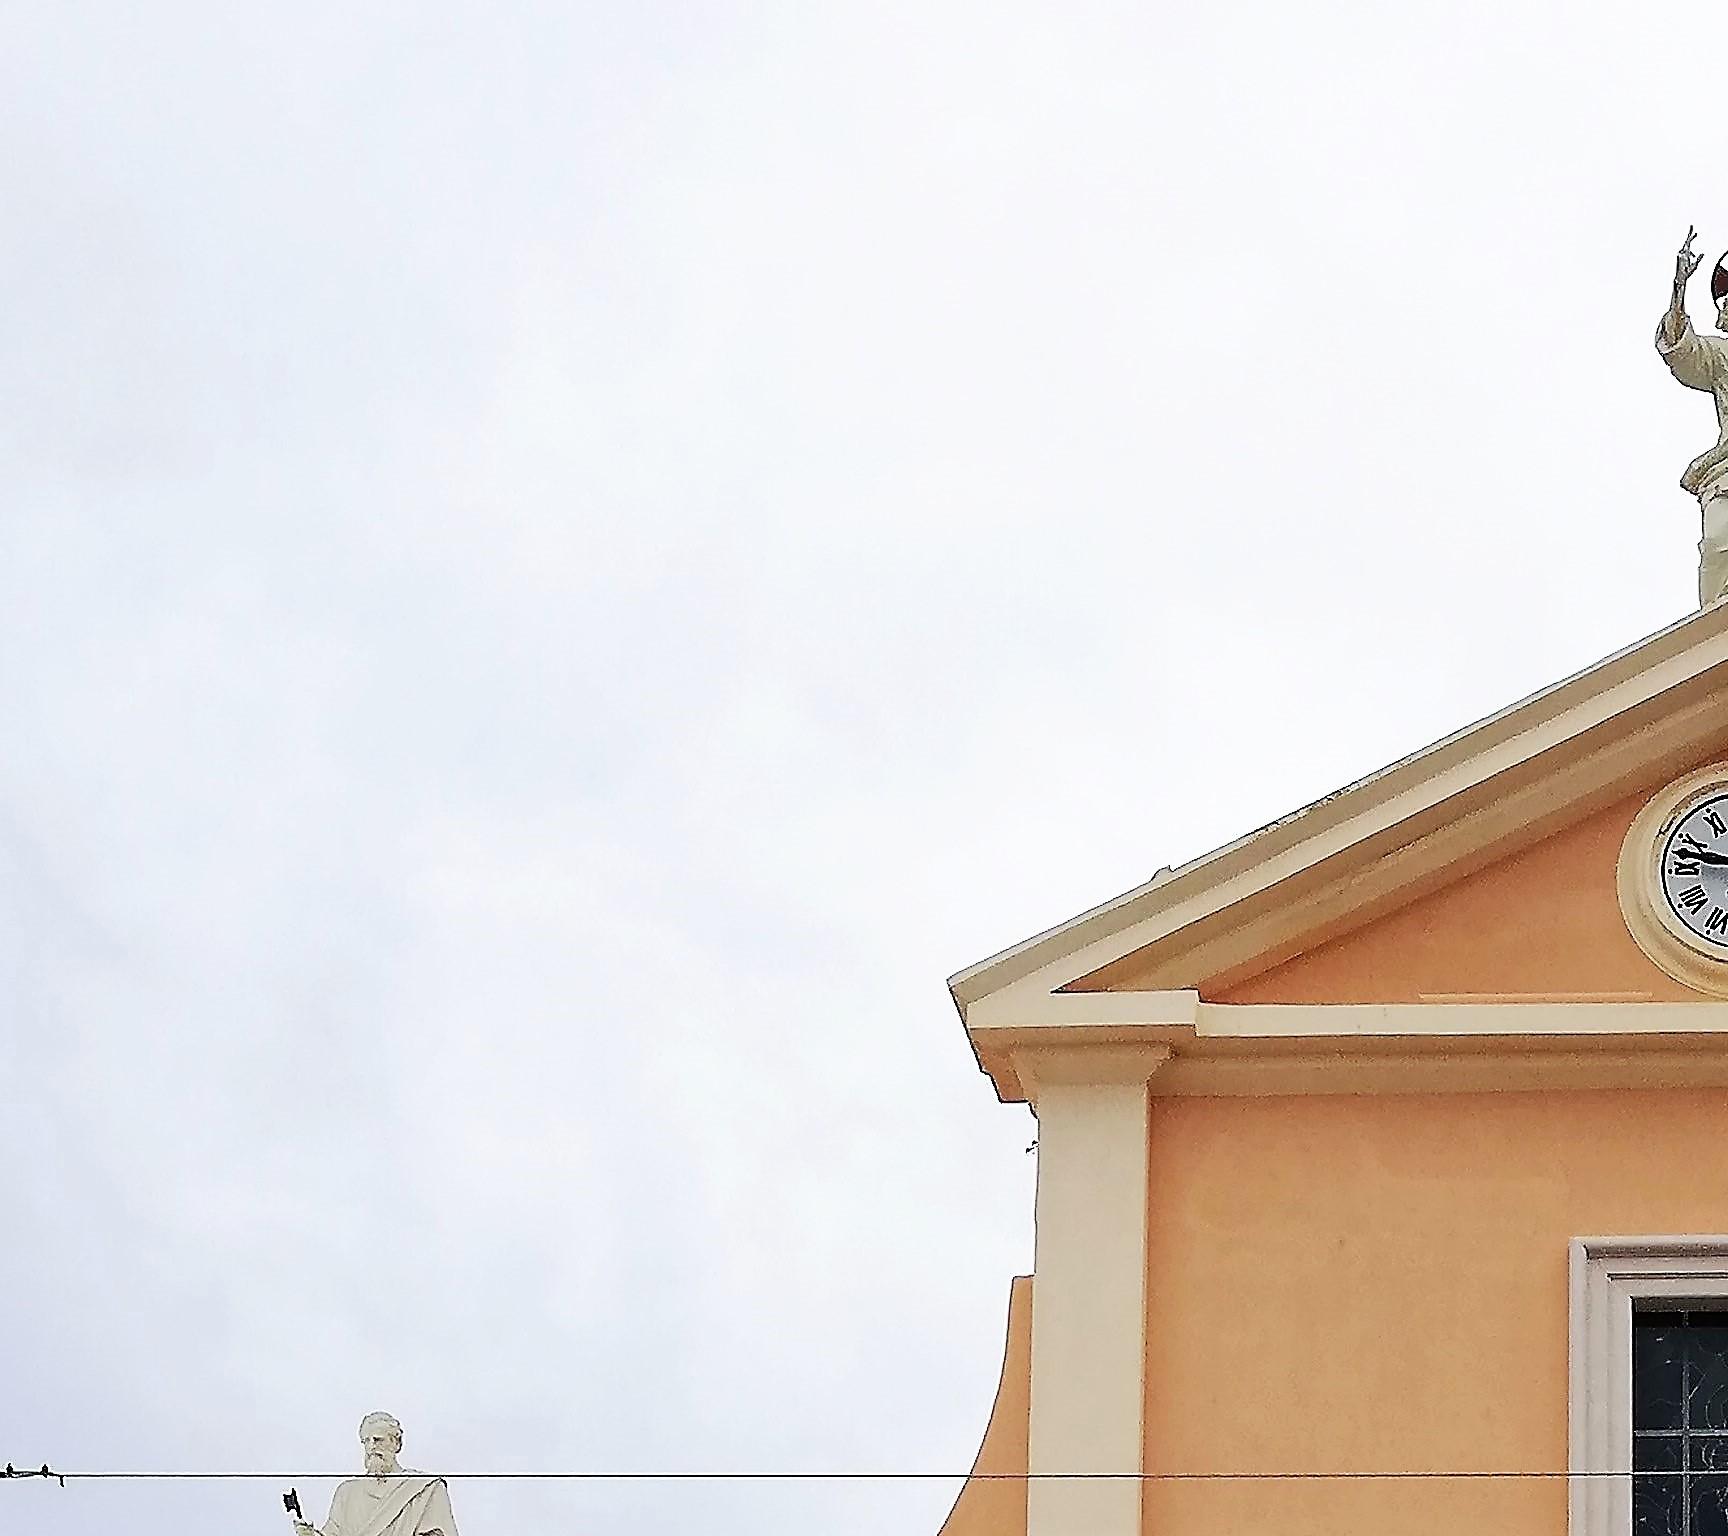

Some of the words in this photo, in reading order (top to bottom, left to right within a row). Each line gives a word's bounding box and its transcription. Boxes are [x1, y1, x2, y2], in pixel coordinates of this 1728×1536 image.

[1703, 812, 1727, 838] XI
[1675, 860, 1700, 876] IX
[1678, 884, 1710, 916] VIII
